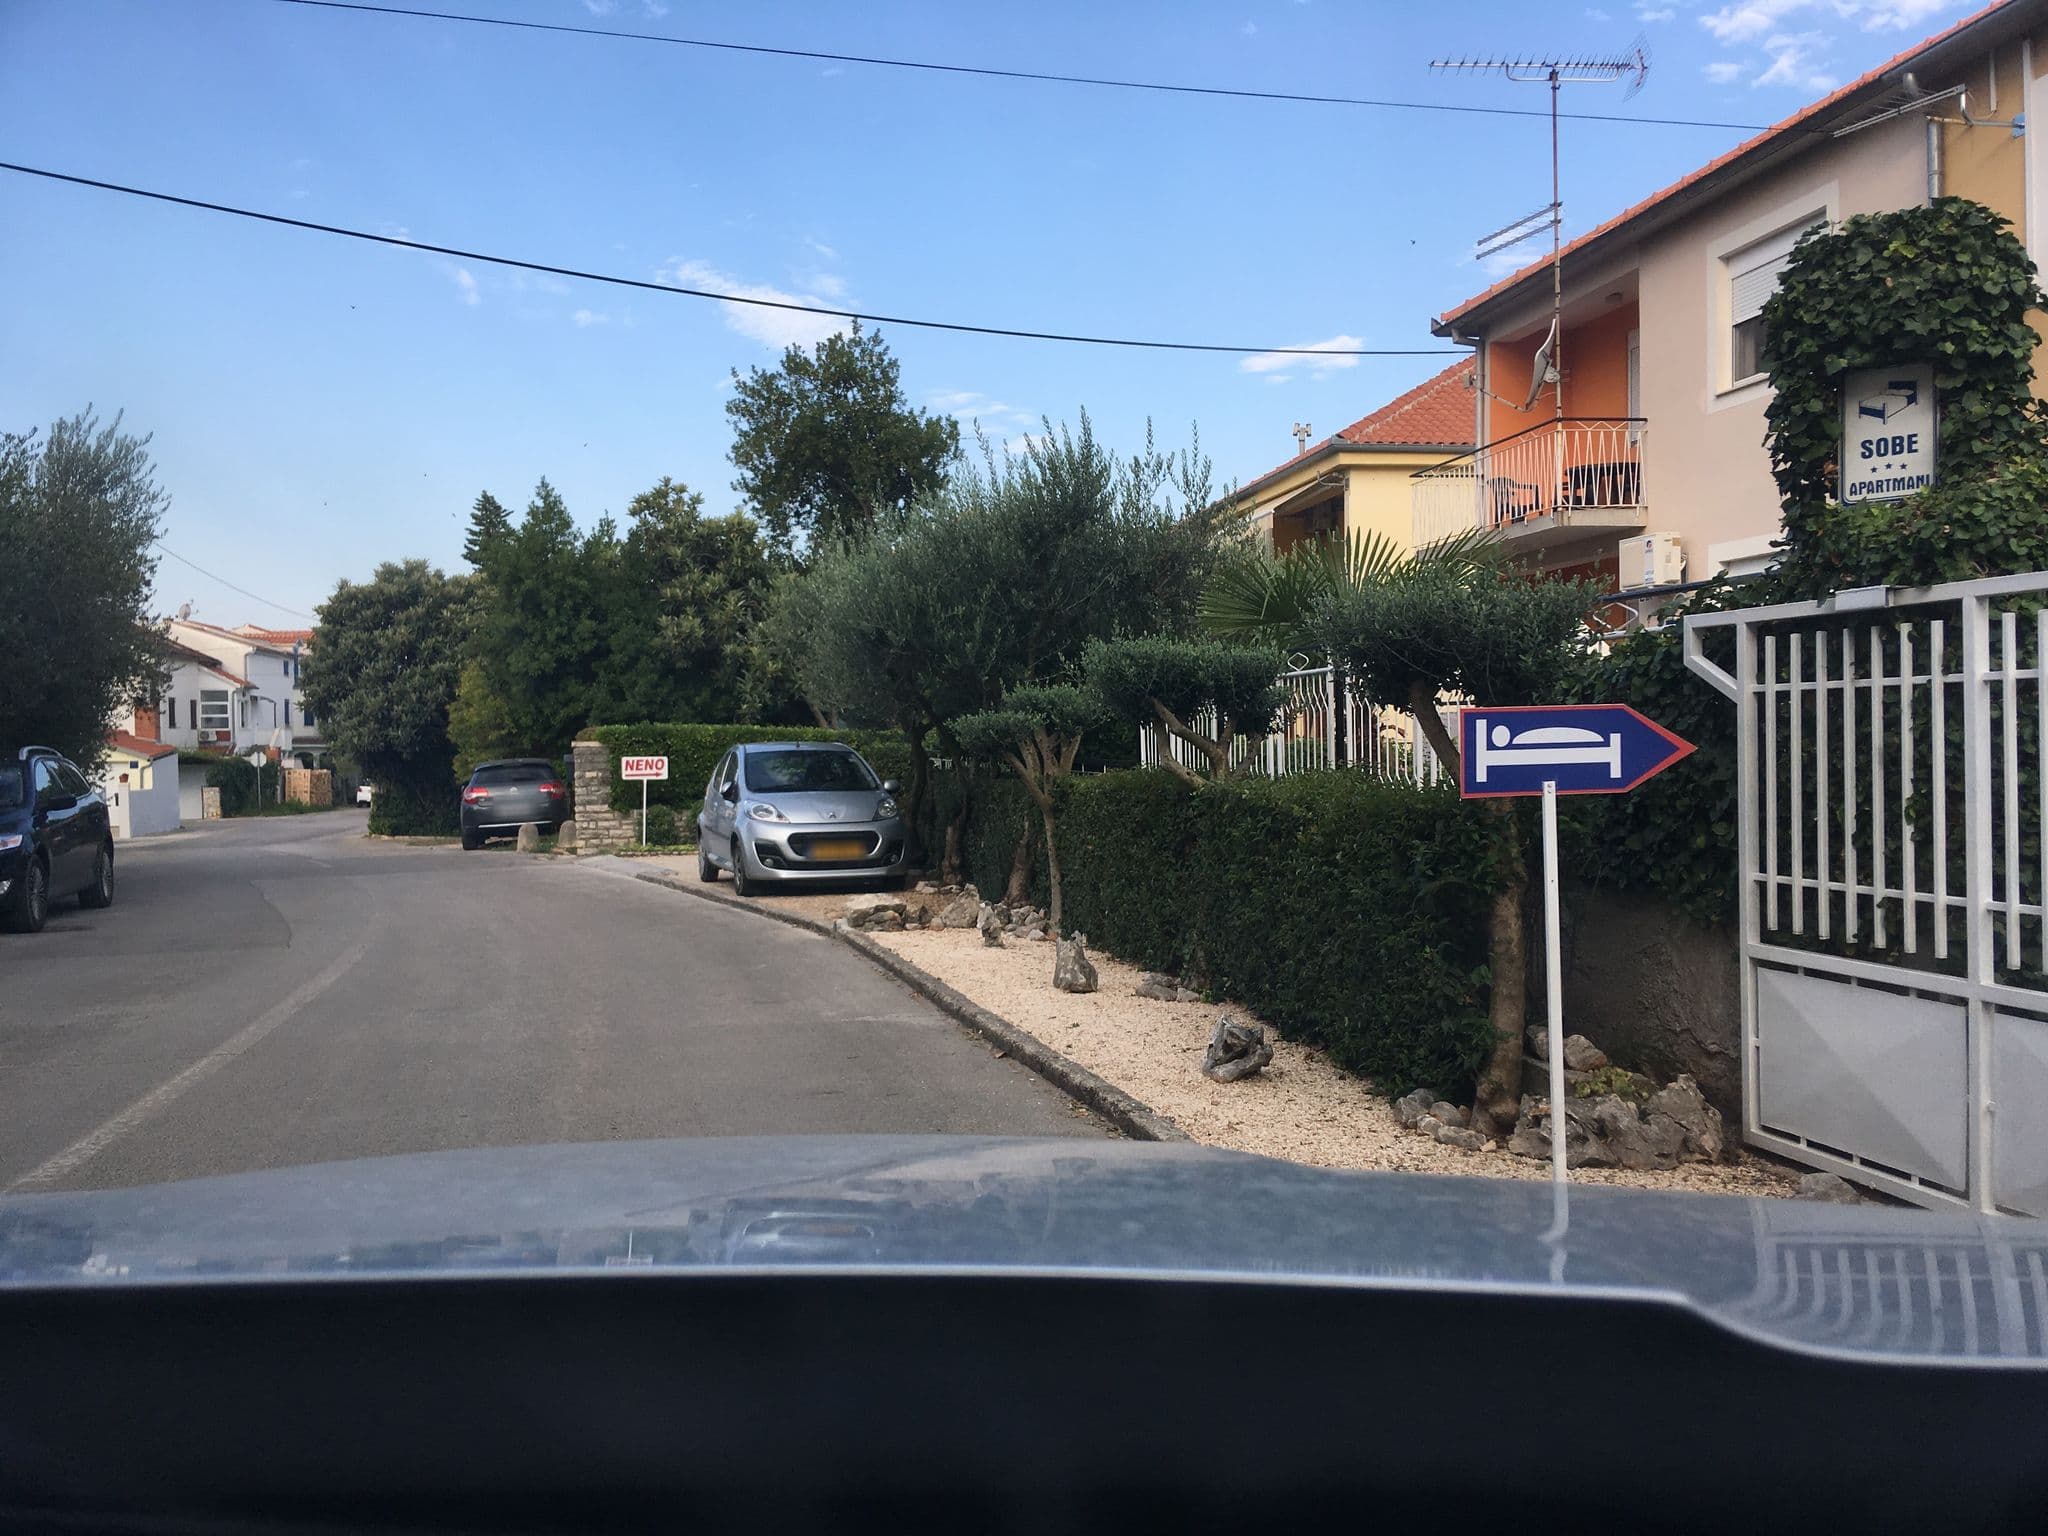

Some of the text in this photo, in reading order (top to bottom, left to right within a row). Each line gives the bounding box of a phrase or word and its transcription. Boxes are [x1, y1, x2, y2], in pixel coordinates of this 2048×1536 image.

[1860, 433, 1918, 459] SOBE
[1849, 474, 1930, 496] APARTMANI
[625, 758, 665, 771] NENO
